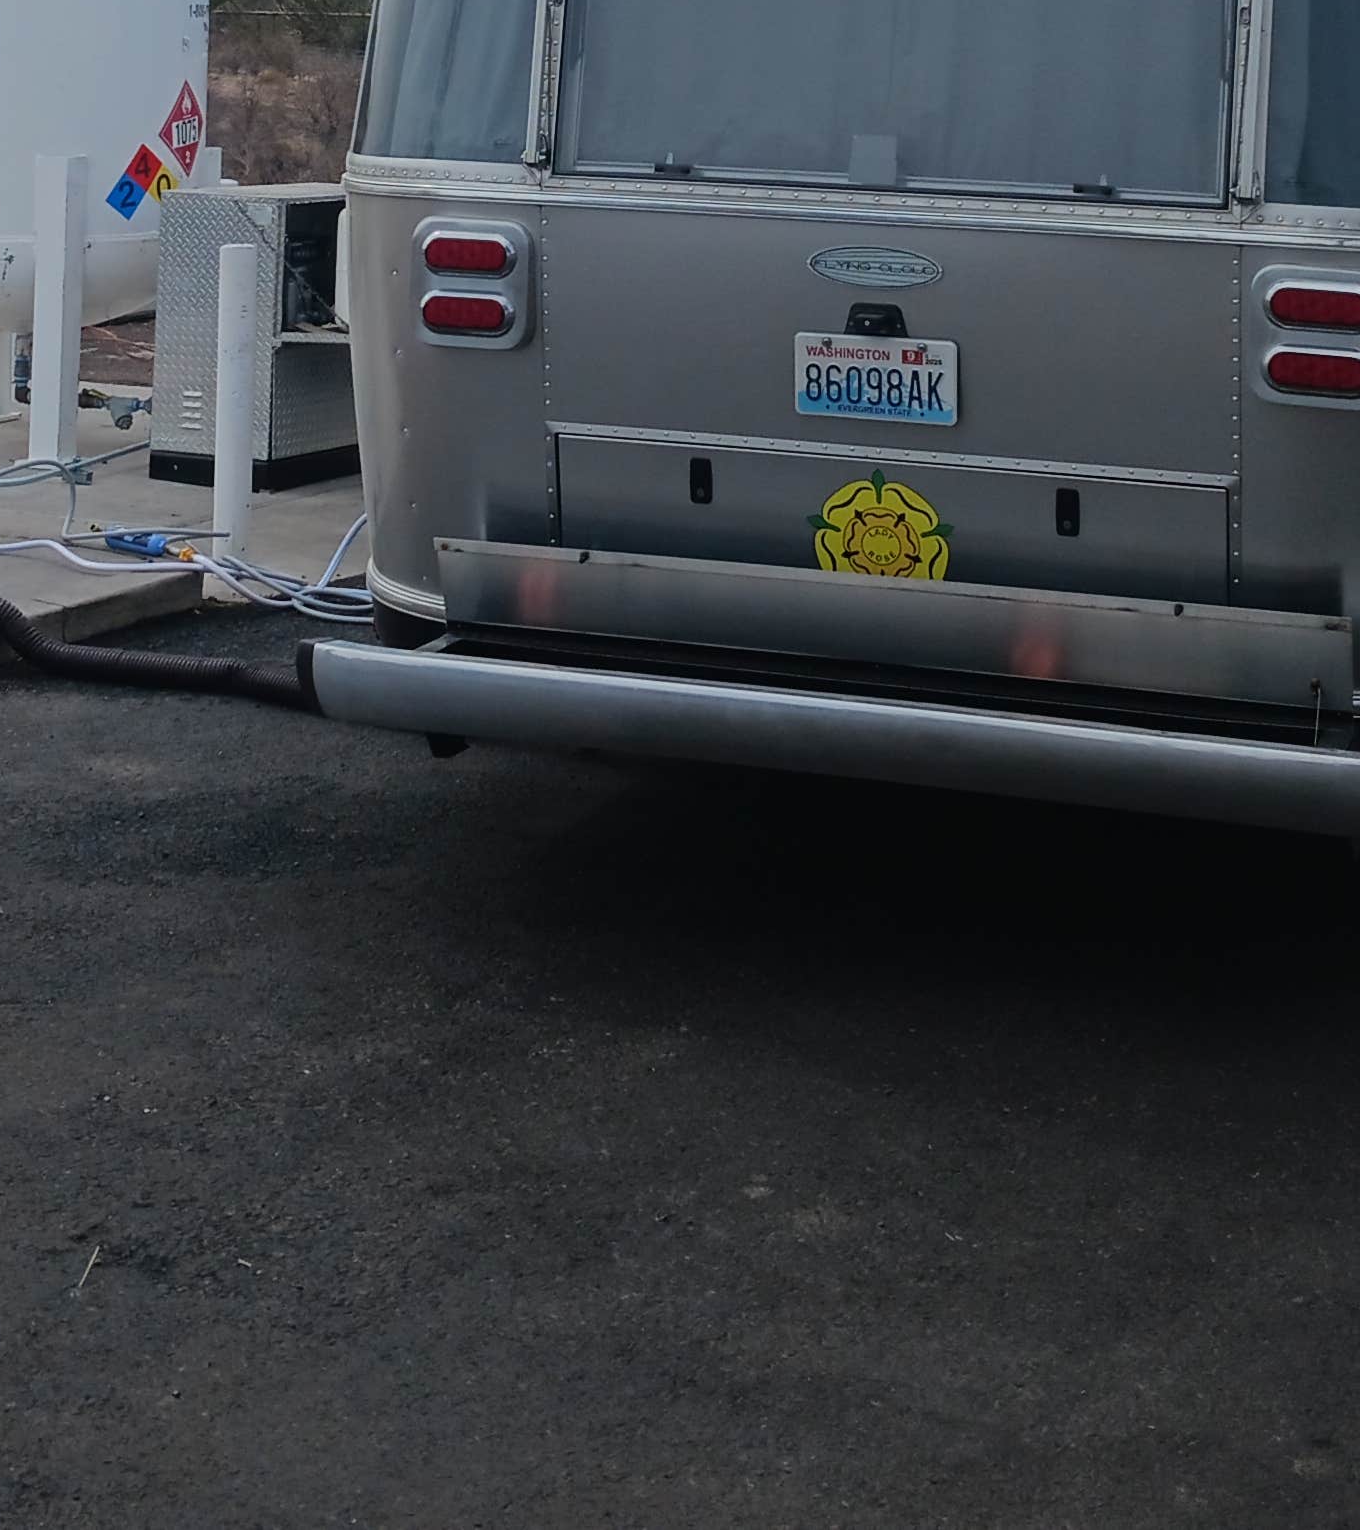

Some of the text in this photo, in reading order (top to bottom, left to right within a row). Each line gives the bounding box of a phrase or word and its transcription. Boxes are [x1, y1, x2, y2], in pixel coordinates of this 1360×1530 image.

[175, 117, 198, 146] 1075
[134, 152, 152, 179] 4
[119, 180, 137, 209] 2
[805, 345, 890, 361] WASHINGTON
[805, 363, 944, 412] 86098AK
[837, 403, 886, 415] EVERGREEN
[868, 528, 895, 539] LADY
[867, 550, 897, 562] ROSE
